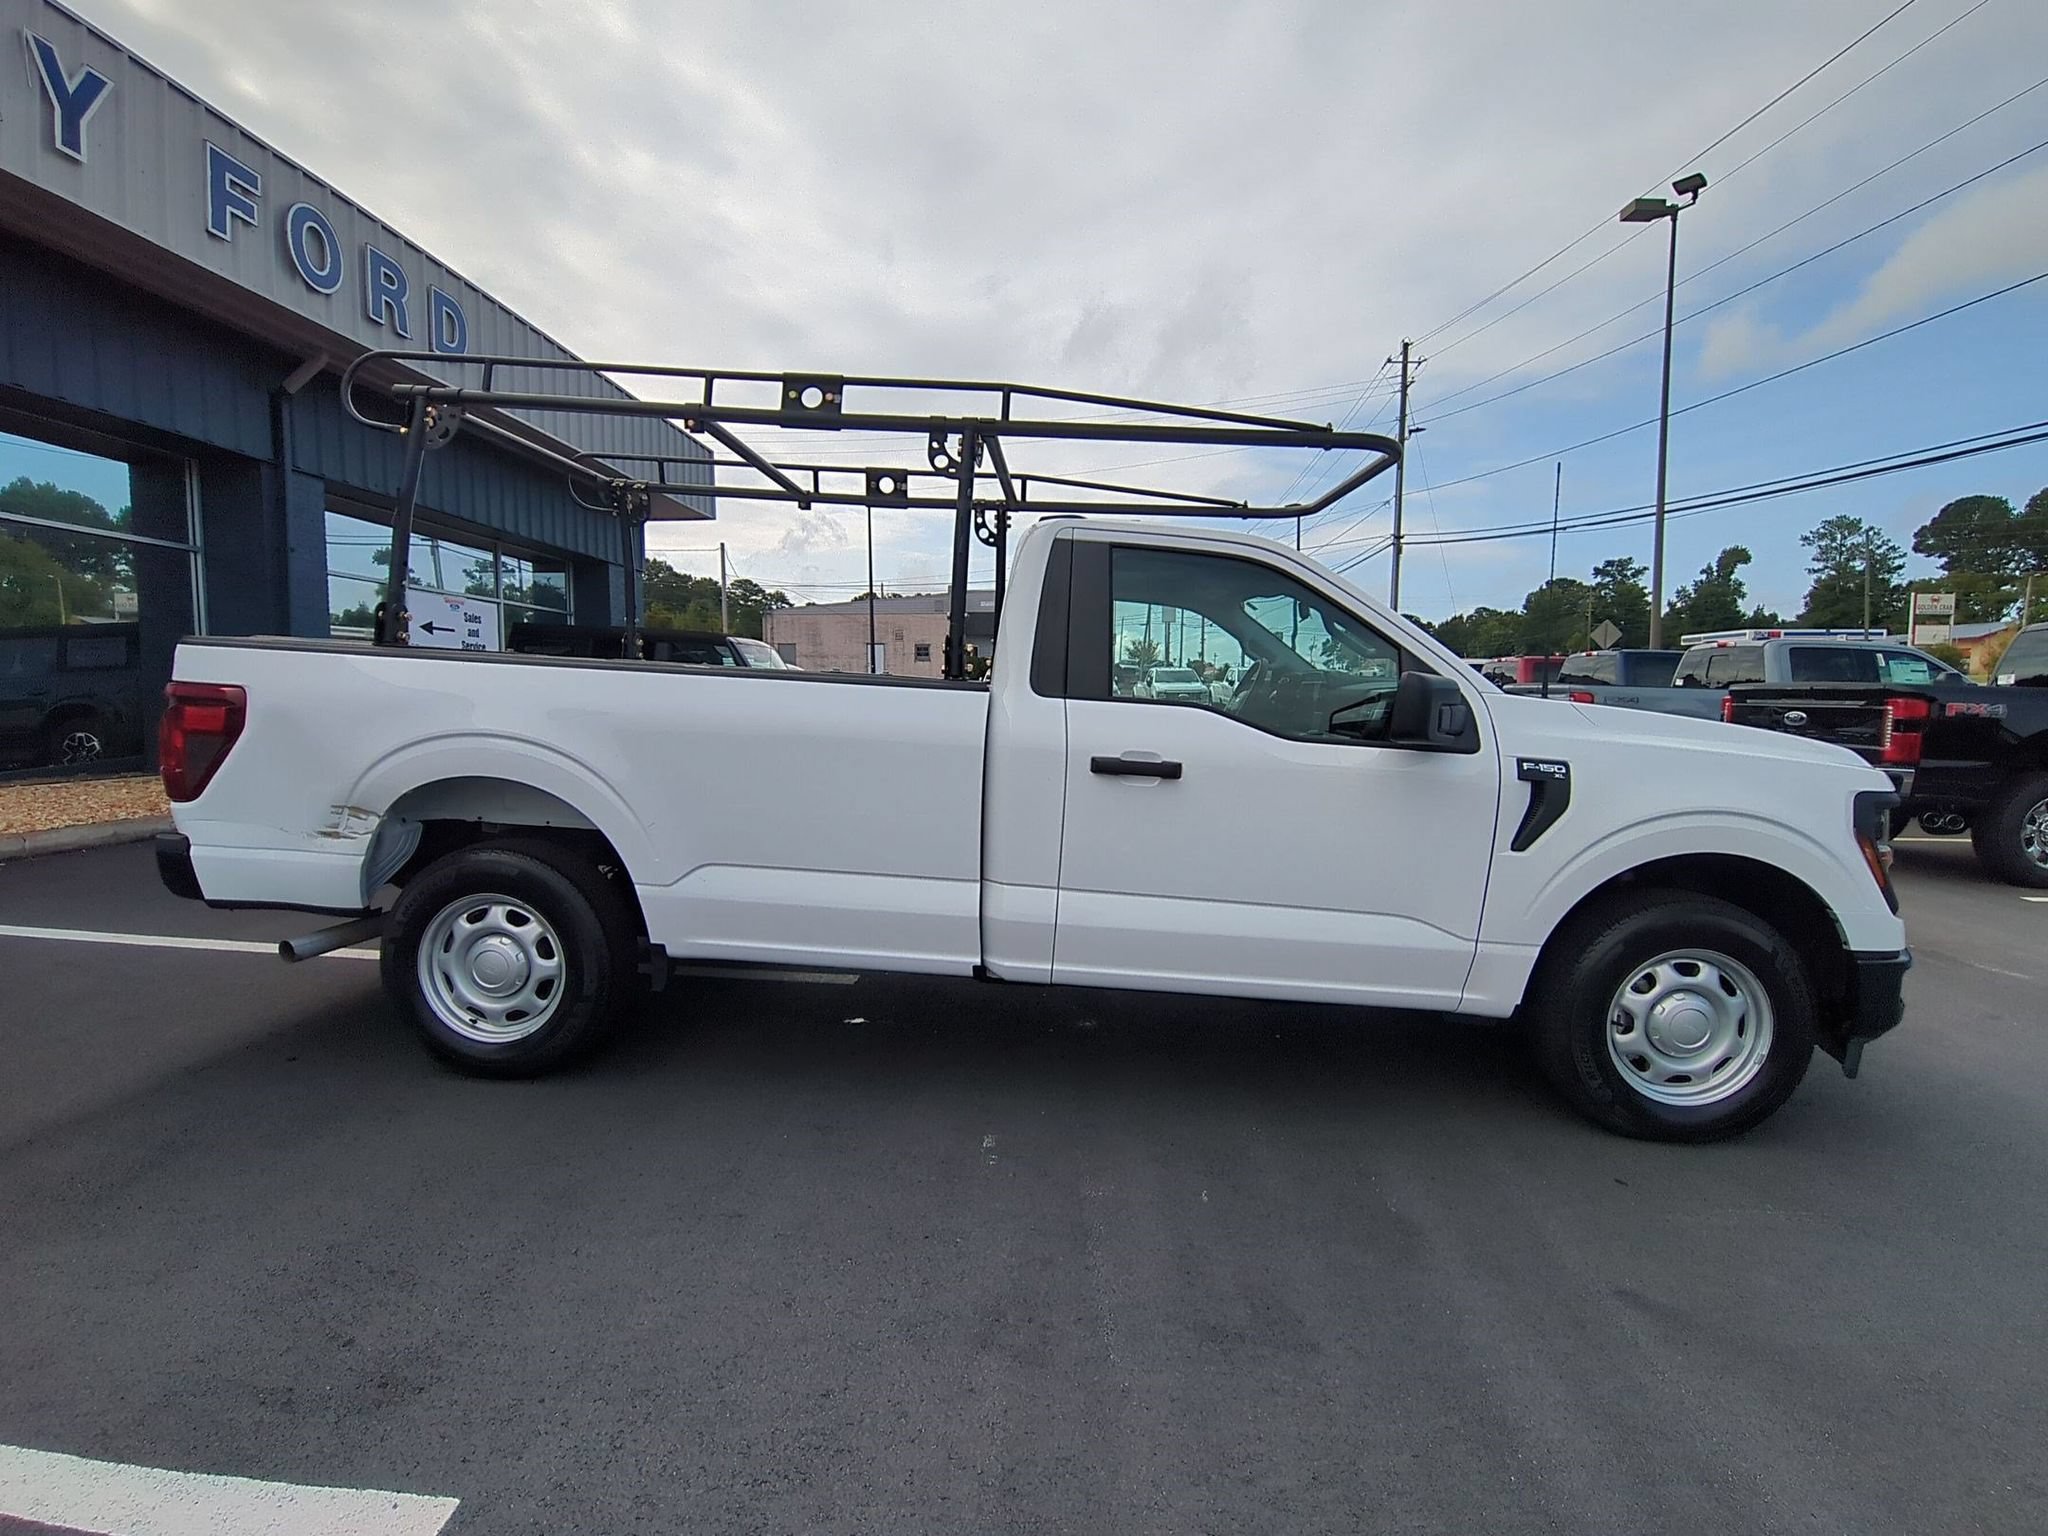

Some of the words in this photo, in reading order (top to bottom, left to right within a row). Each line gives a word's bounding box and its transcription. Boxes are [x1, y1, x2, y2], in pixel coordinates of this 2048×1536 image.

[206, 139, 469, 354] FORD
[463, 612, 482, 624] Sales
[467, 628, 480, 638] and
[461, 640, 487, 650] Service
[1945, 702, 2008, 719] FX4
[1522, 762, 1566, 773] F-150
